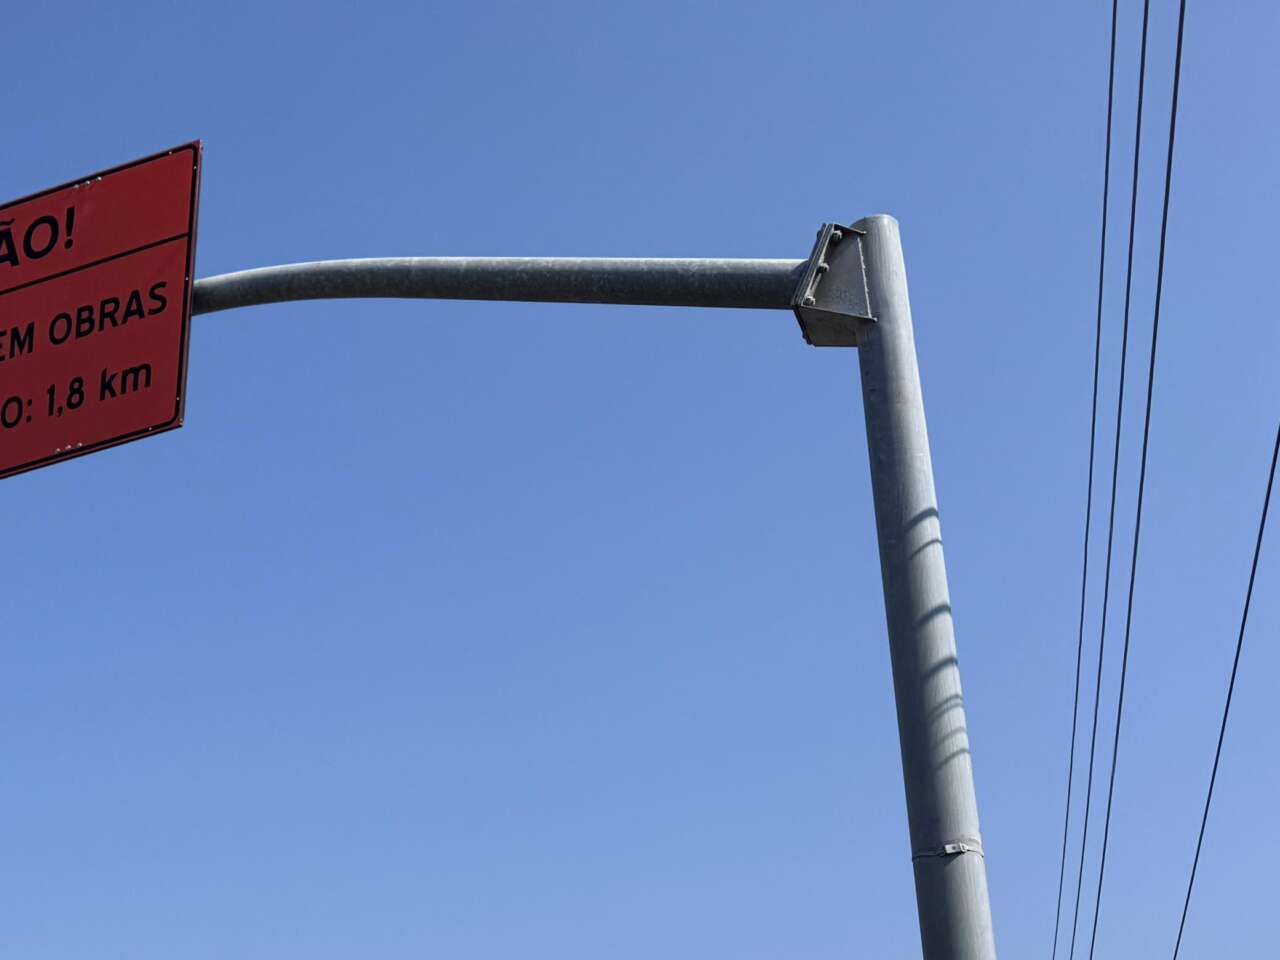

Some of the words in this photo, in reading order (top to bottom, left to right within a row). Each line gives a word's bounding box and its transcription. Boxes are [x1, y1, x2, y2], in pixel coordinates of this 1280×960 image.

[48, 281, 168, 346] OBRAS
[47, 376, 85, 419] 1,8
[98, 362, 153, 401] km
